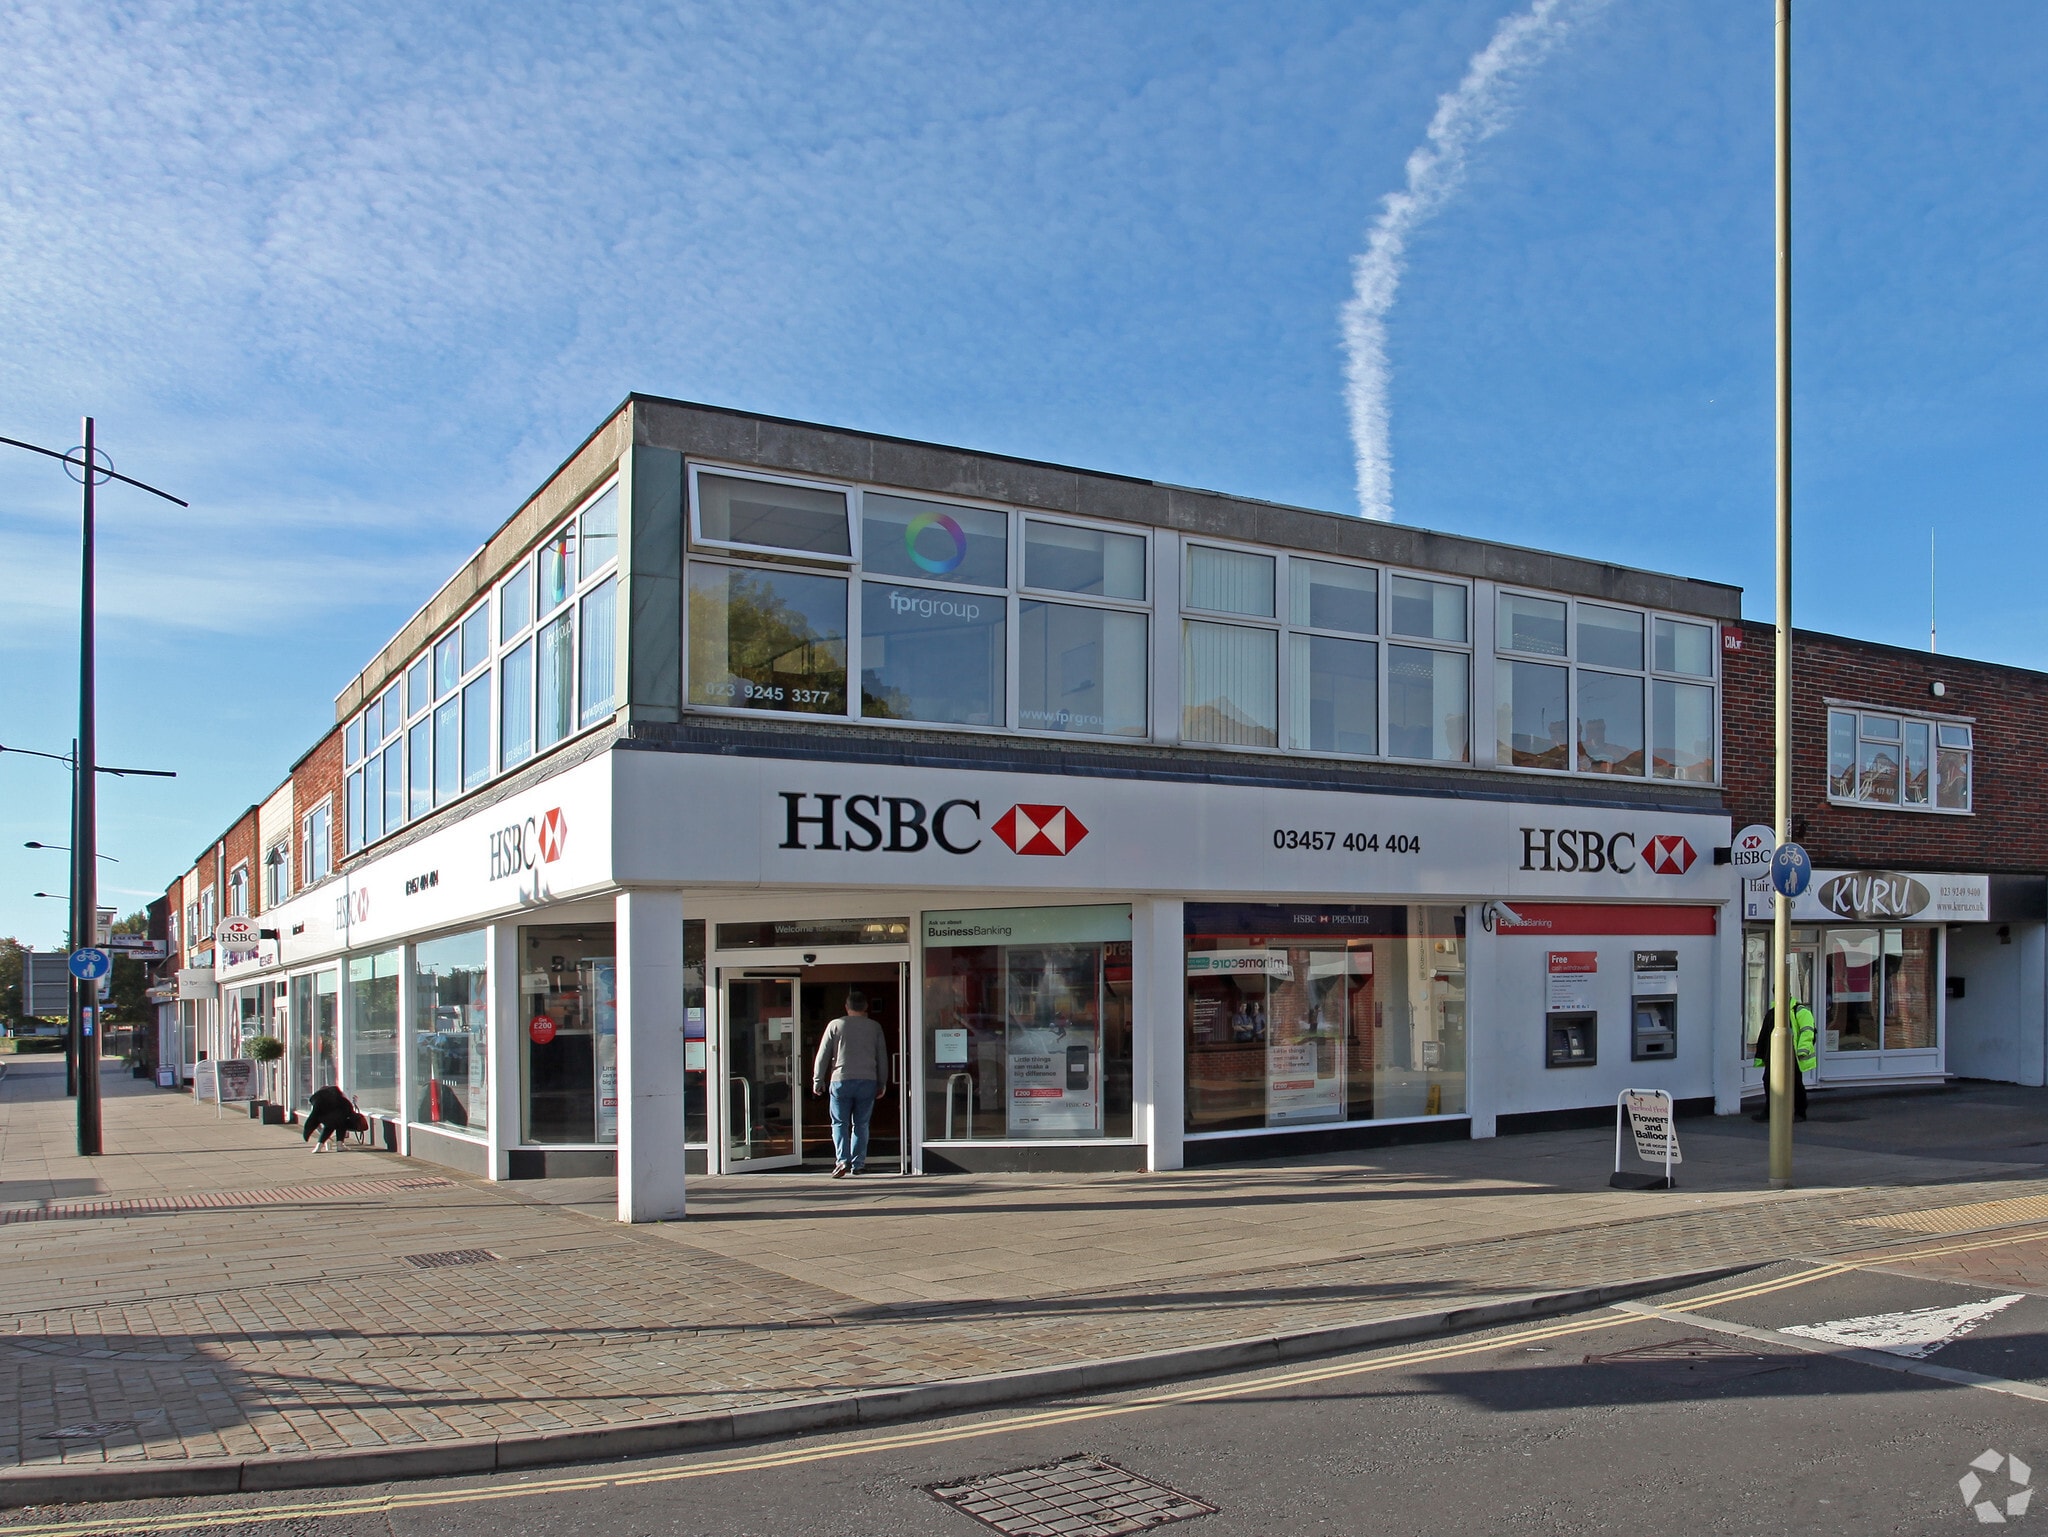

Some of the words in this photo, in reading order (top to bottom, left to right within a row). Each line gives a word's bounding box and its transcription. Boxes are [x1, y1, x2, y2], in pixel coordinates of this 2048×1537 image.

[889, 591, 980, 622] fprgroup
[705, 682, 736, 697] 023
[744, 685, 784, 701] 9245
[791, 689, 830, 705] 3377
[778, 791, 981, 854] HSBC
[1273, 829, 1336, 851] 03457
[1343, 831, 1380, 852] 404
[1385, 833, 1421, 854] 404
[489, 817, 537, 881] HSBC
[1519, 827, 1636, 874] HSBC
[1735, 850, 1772, 865] HSBC
[1750, 879, 1770, 892] Hair
[1940, 887, 1951, 897] 023
[1832, 876, 1910, 916] KURU
[1293, 915, 1316, 923] HSBC
[1332, 915, 1369, 924] PREMIER
[775, 926, 813, 934] Welcome
[928, 925, 1012, 937] BusinessBanking
[221, 933, 258, 942] HSBC
[1551, 955, 1568, 963] Free
[1637, 953, 1649, 963] Pay
[1651, 953, 1657, 961] in
[1633, 1113, 1668, 1124] Flowers
